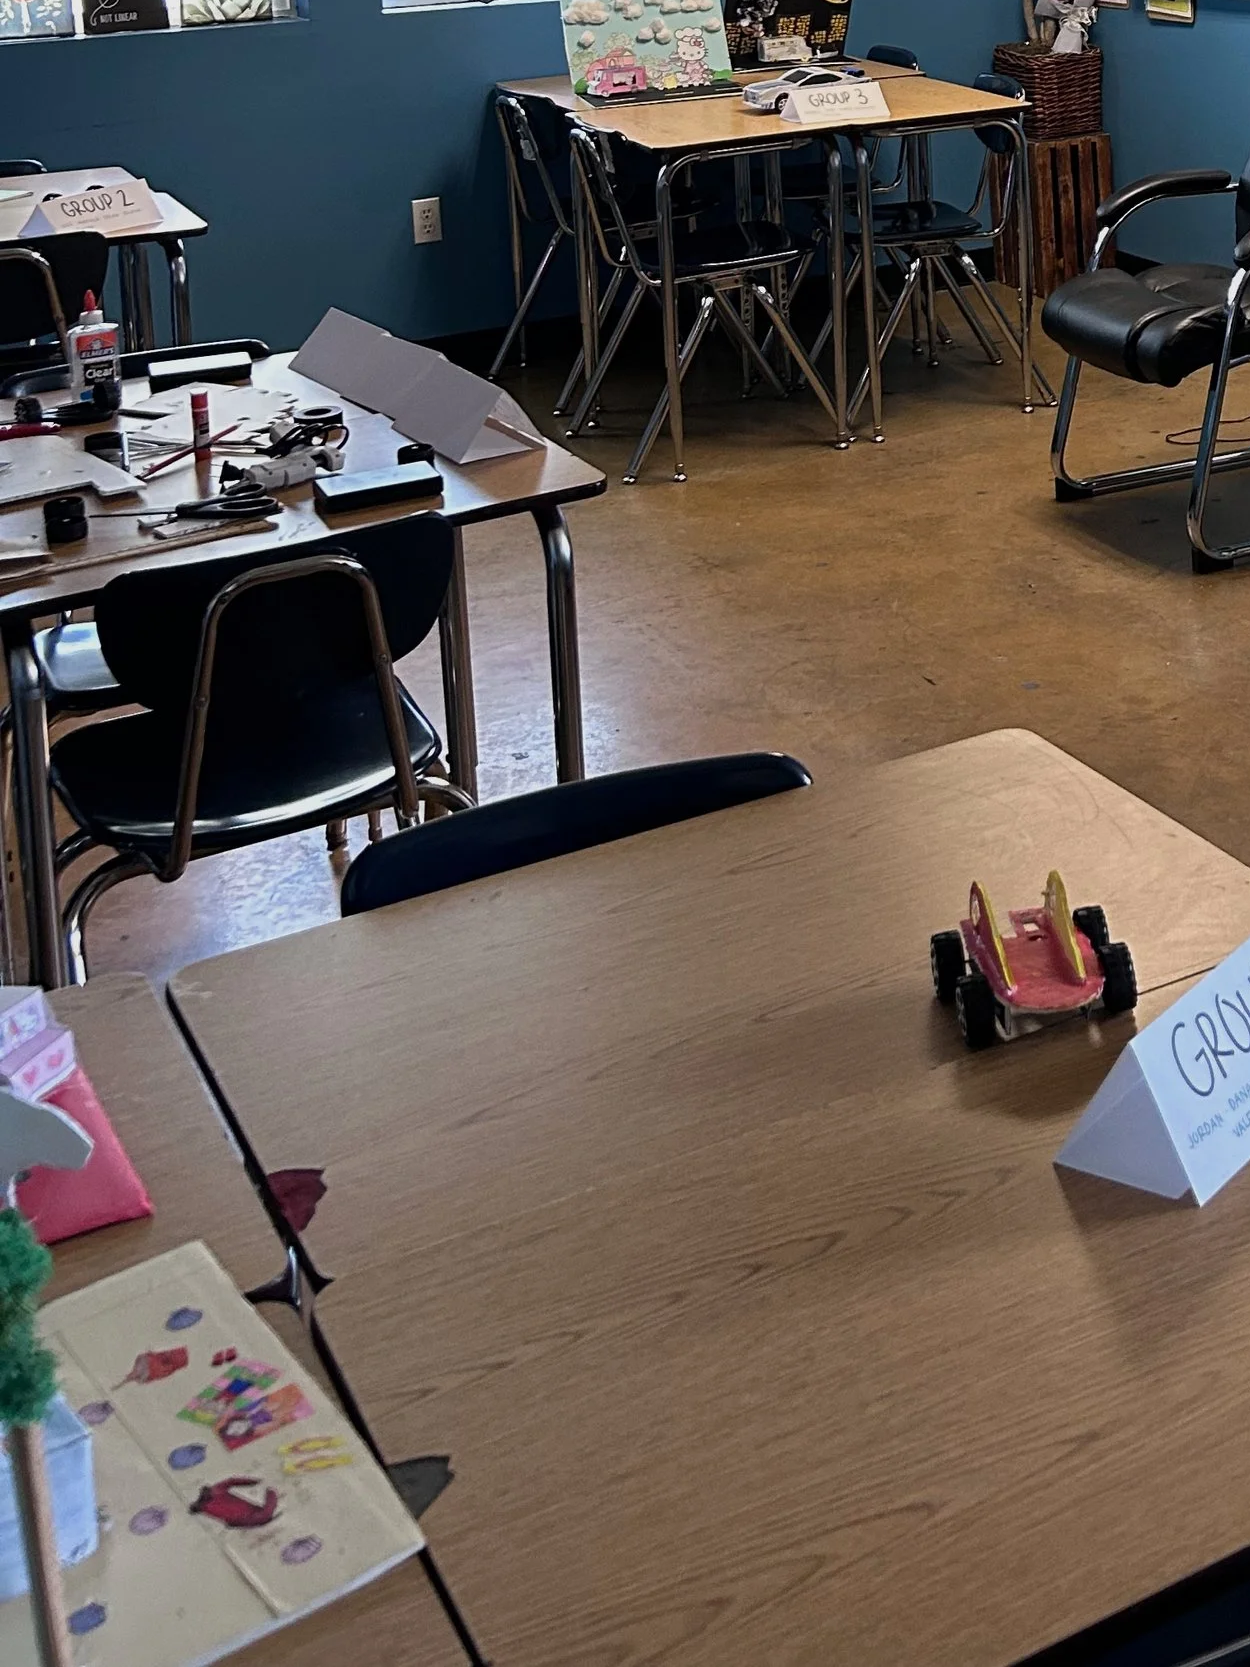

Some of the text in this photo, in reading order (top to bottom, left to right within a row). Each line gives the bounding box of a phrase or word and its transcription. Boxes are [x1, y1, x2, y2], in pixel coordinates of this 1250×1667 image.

[99, 11, 138, 24] NOT LINEAR
[807, 88, 869, 108] GROUP 3
[60, 189, 135, 218] GROUP 2
[80, 347, 115, 359] ELMER'S
[85, 366, 114, 380] Clear
[1188, 1114, 1224, 1149] JORDAN
